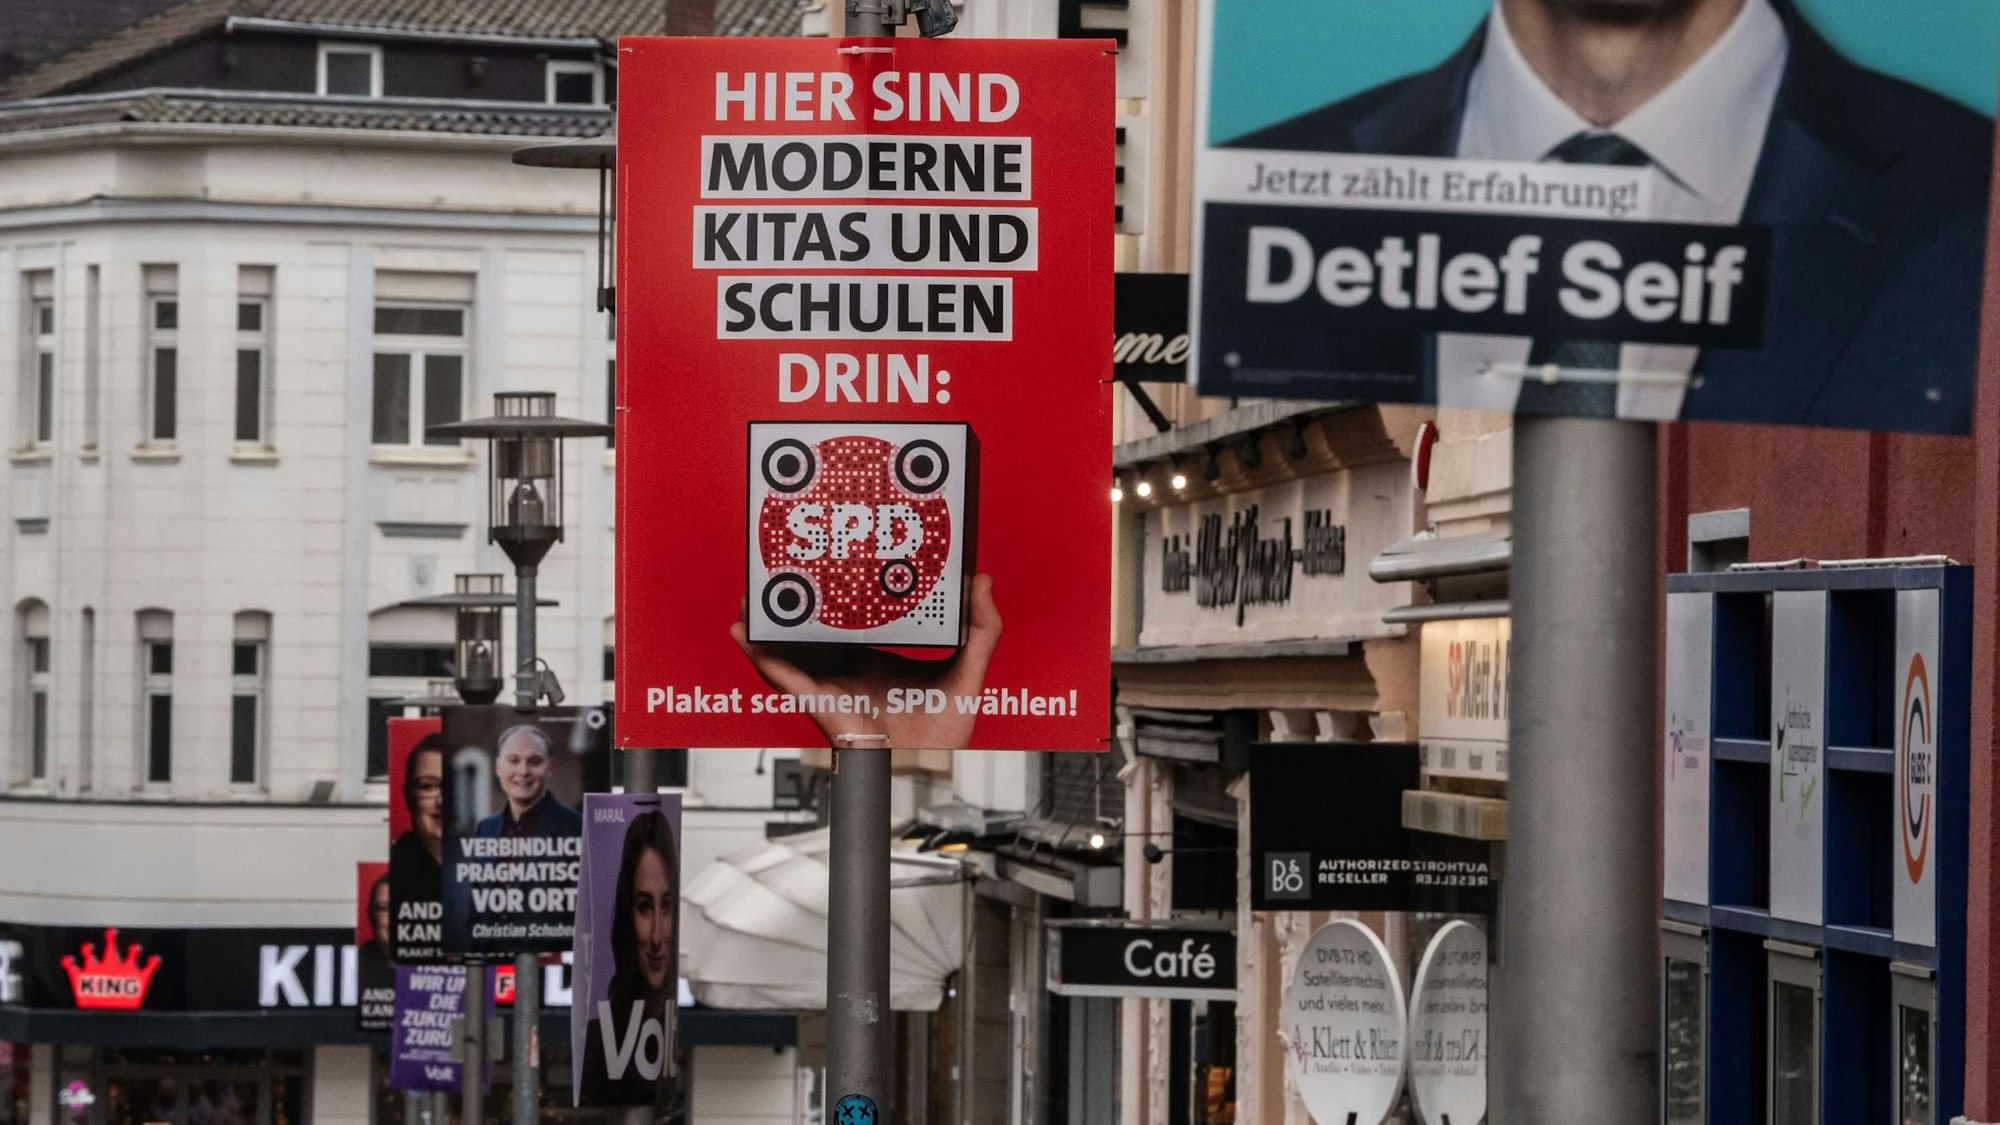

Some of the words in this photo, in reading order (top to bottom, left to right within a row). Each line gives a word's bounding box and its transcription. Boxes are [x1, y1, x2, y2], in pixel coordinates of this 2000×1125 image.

[715, 72, 855, 122] HIER
[872, 71, 1020, 123] SIND
[707, 142, 1023, 193] MODERNE
[1247, 163, 1332, 197] Jetzt
[1341, 168, 1432, 201] zählt
[1442, 171, 1639, 219] Erfahrung!
[704, 212, 871, 262] KITAS
[891, 213, 1030, 264] UND
[1246, 226, 1543, 315] Detlef
[1558, 240, 1747, 325] Seif
[724, 282, 1005, 334] SCHULEN
[778, 353, 952, 405] DRIN:
[785, 503, 924, 560] SPD
[646, 686, 743, 715] Plakat
[750, 692, 880, 720] scannen,
[886, 688, 947, 715] SPD
[955, 688, 1079, 717] wählen!
[1911, 753, 1926, 784] GLEIS
[594, 808, 625, 823] MARAL
[456, 862, 580, 882] PRAGMATISC
[1318, 872, 1388, 884] RESELLER
[1319, 859, 1410, 871] AUTHORIZED
[471, 887, 525, 913] VOR
[528, 887, 578, 912] ORT
[472, 922, 527, 938] Christian
[1124, 938, 1216, 979] Café
[80, 976, 139, 996] KING
[410, 973, 444, 991] WIR
[430, 993, 460, 1010] DIE
[1298, 994, 1324, 1011] und
[1328, 995, 1359, 1011] vieles
[401, 1009, 464, 1028] ZUKU
[597, 999, 678, 1080] Volt
[1312, 1026, 1350, 1059] Klett
[1354, 1030, 1366, 1060] &
[424, 1065, 454, 1081] Volt
